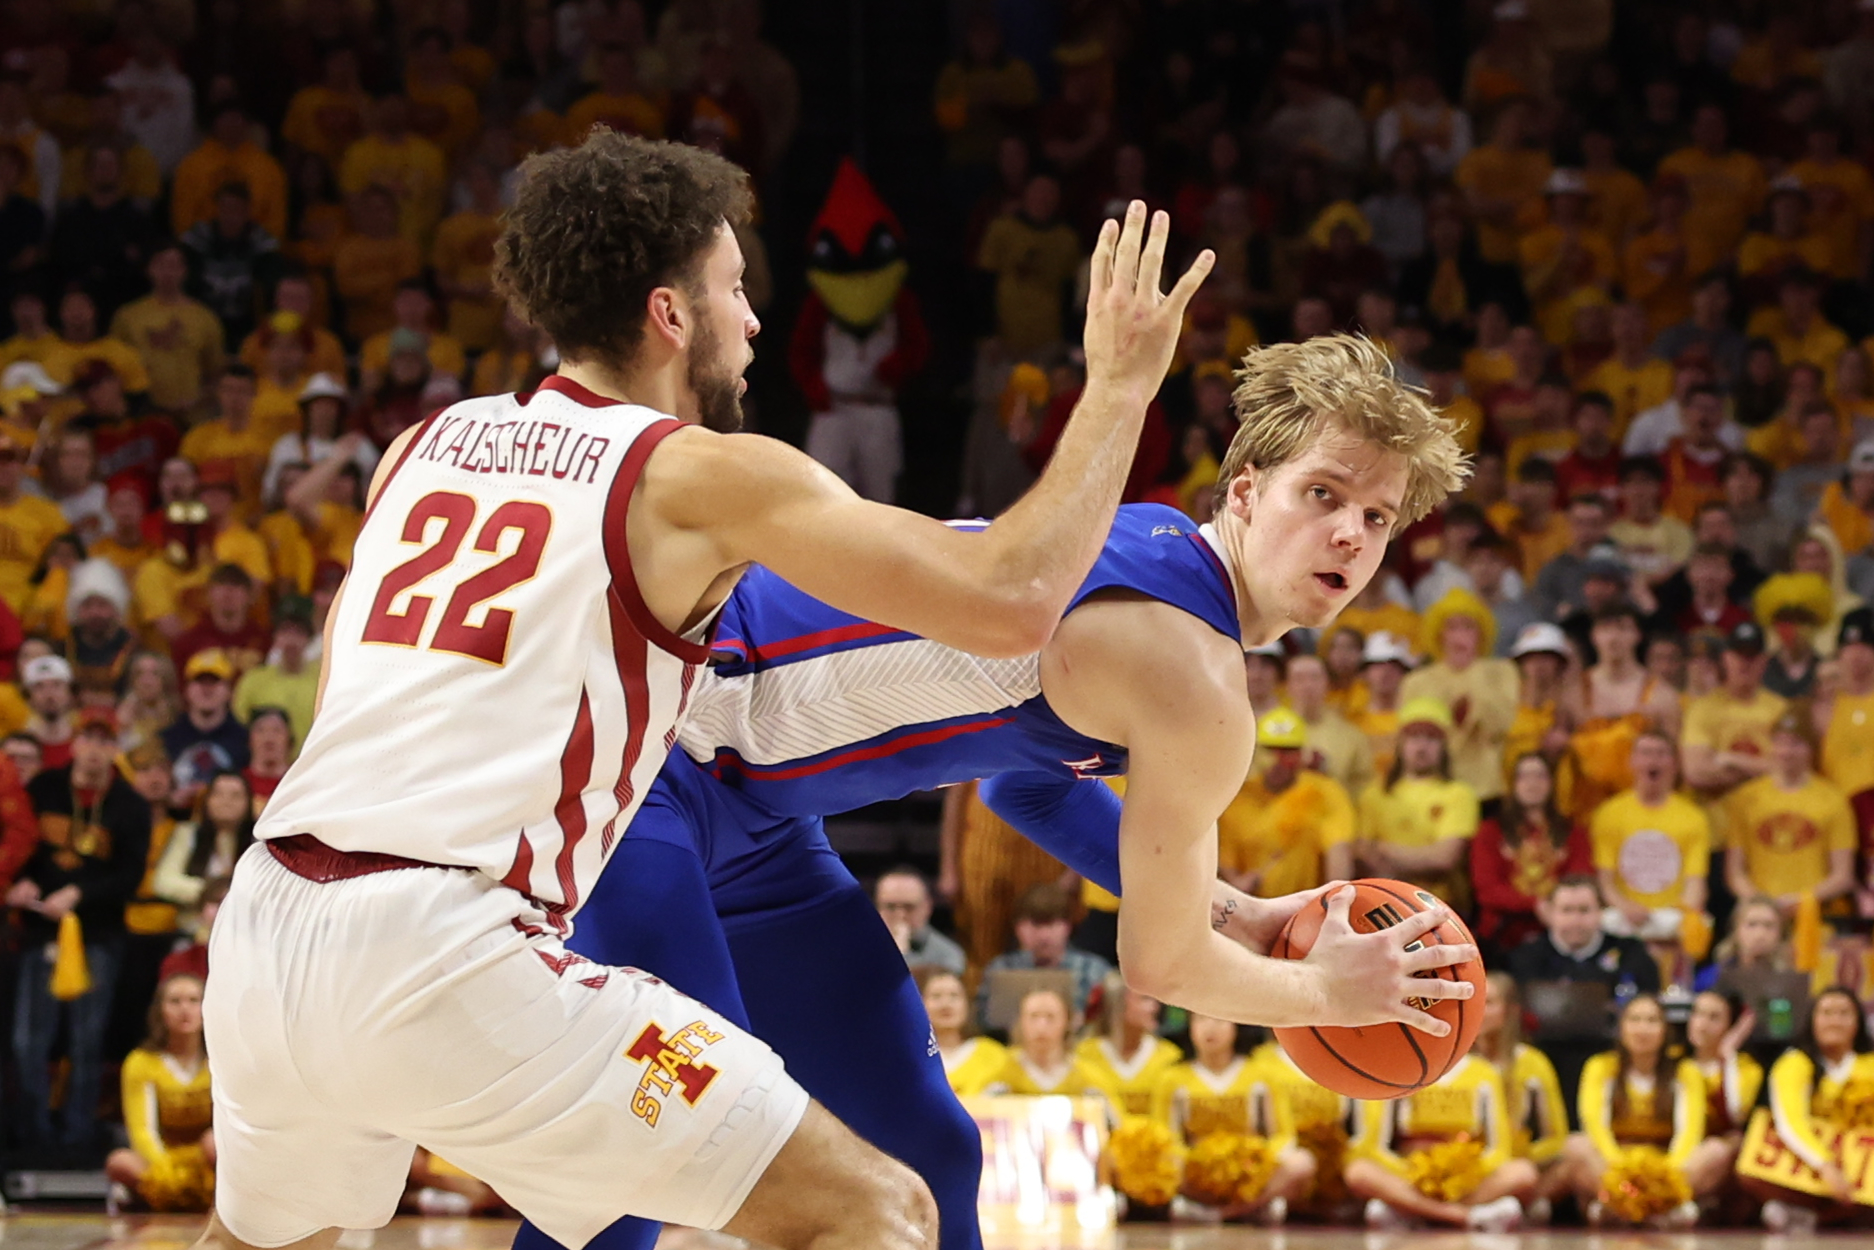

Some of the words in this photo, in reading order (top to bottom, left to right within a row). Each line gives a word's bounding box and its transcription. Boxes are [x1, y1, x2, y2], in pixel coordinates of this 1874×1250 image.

[418, 415, 610, 484] KALSCHEUR
[359, 490, 552, 668] 22
[630, 1020, 726, 1128] STATE
